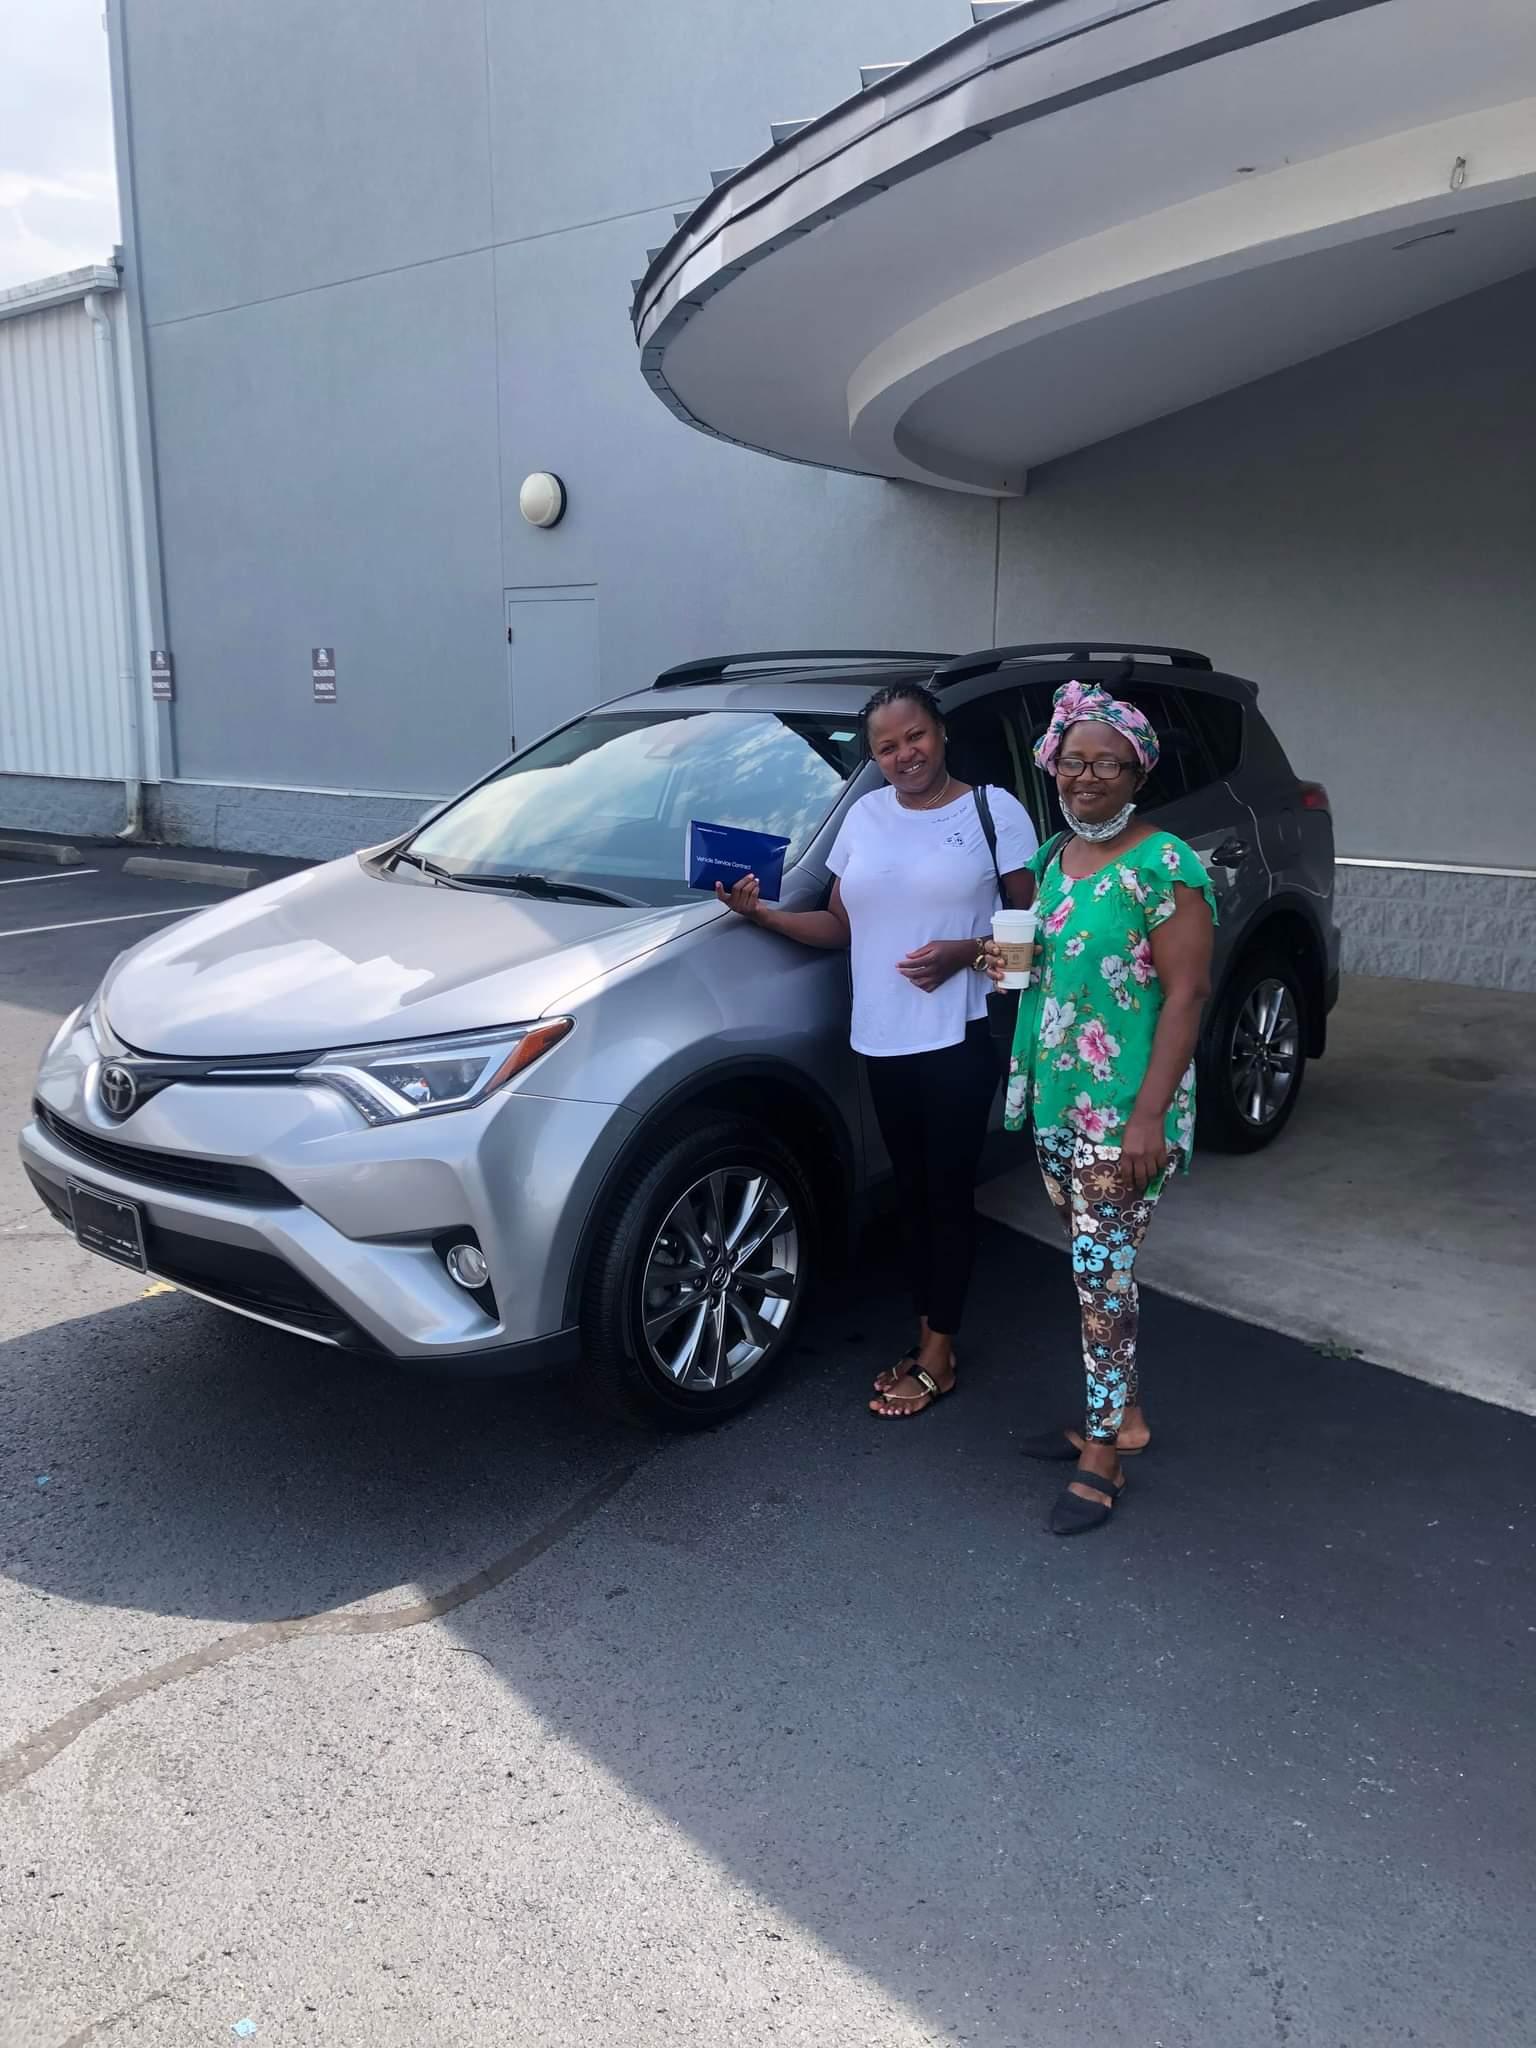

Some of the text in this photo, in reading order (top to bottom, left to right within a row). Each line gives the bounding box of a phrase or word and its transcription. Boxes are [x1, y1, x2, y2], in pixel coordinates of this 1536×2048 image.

[696, 855, 752, 870] Vehicle Service Contract
